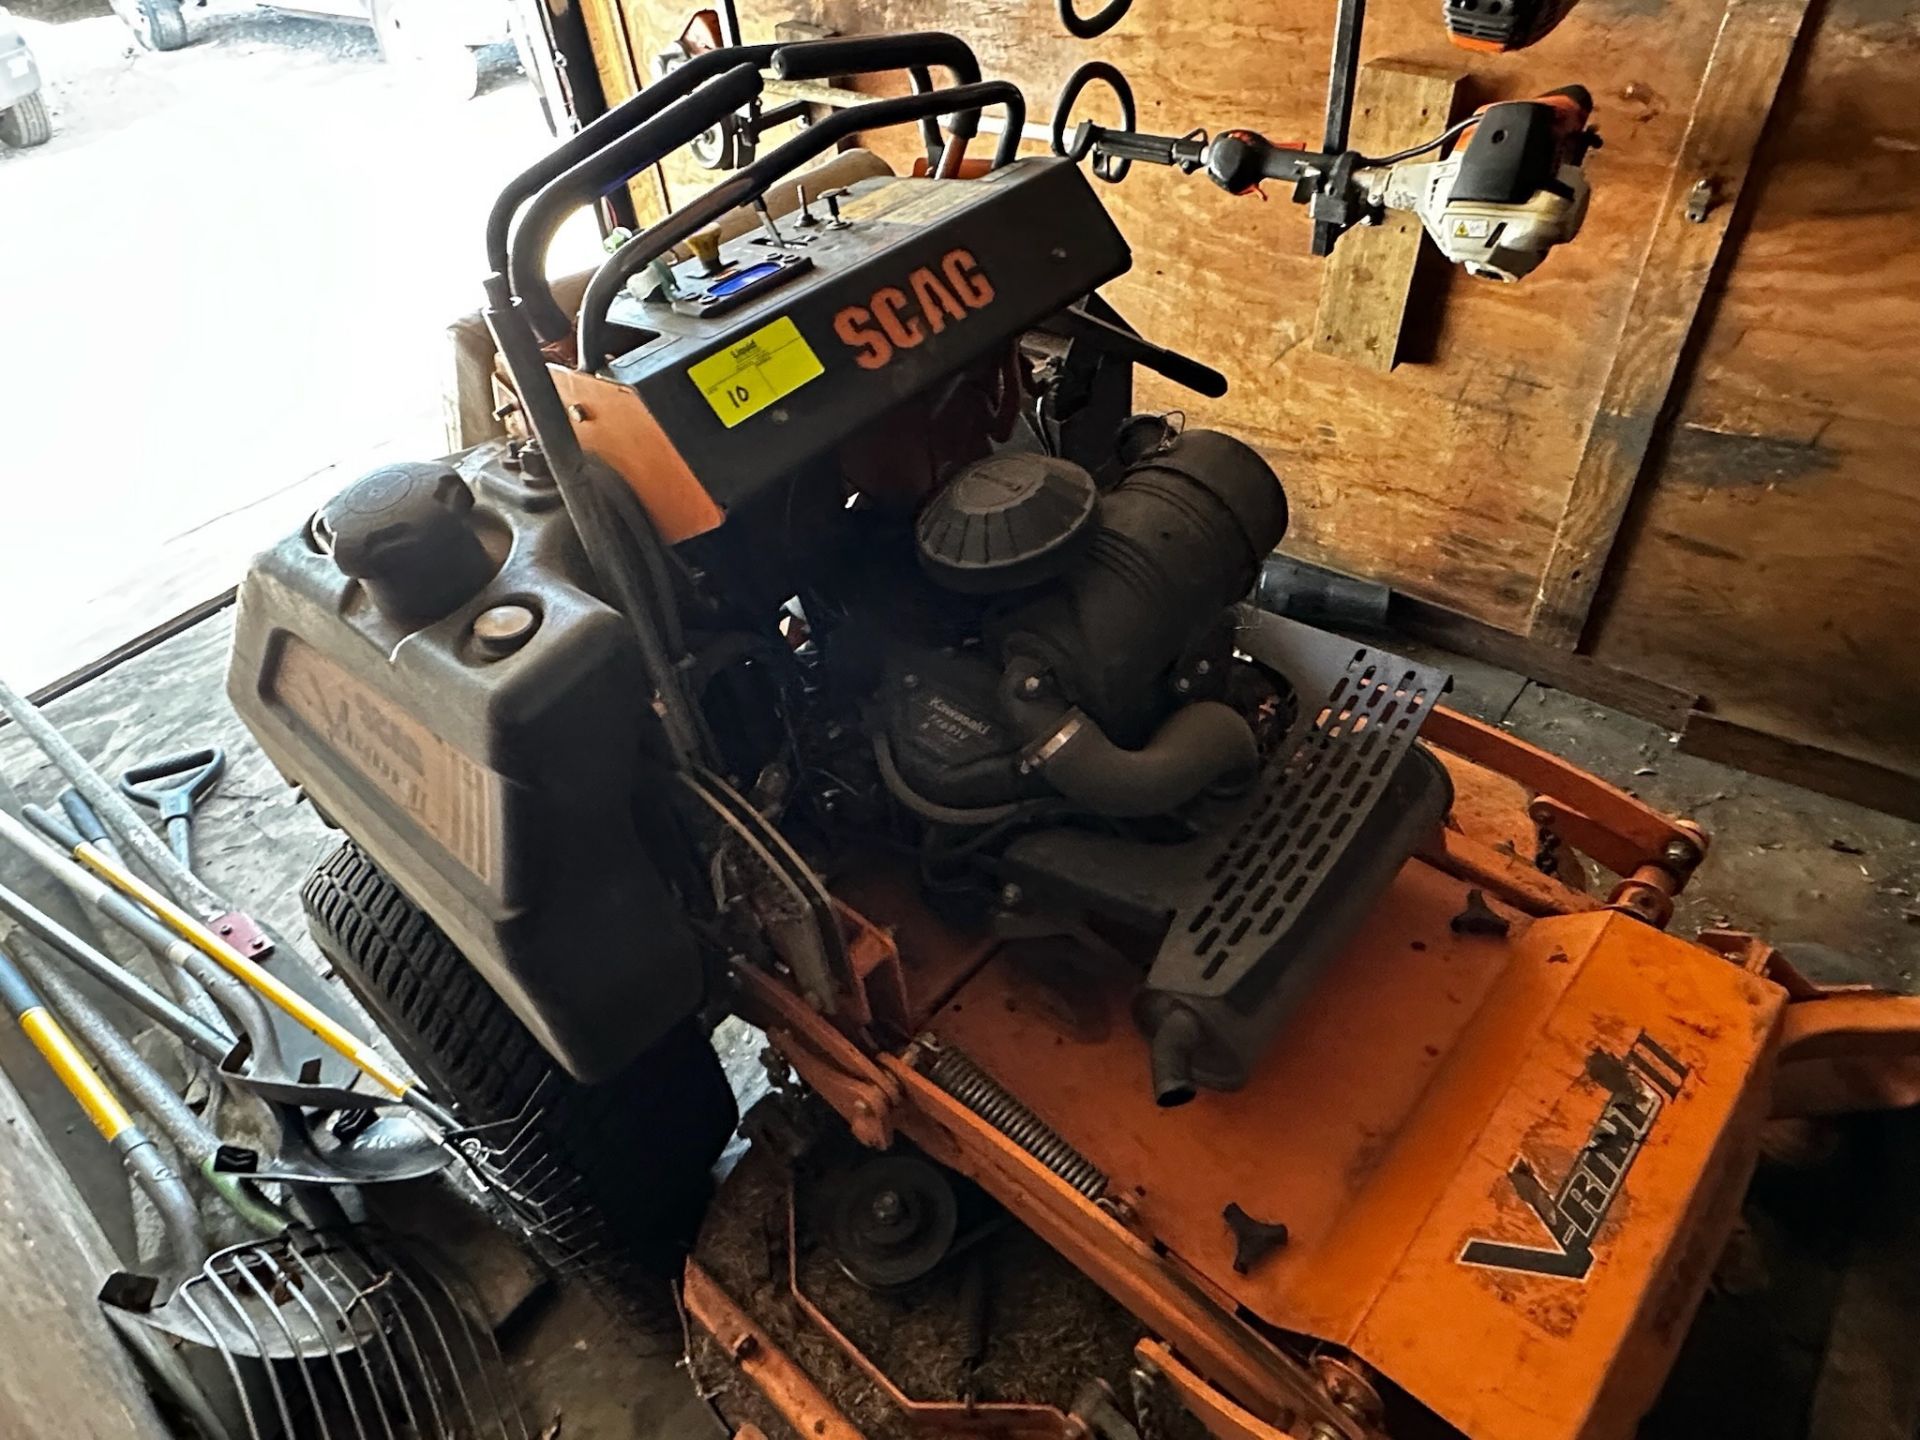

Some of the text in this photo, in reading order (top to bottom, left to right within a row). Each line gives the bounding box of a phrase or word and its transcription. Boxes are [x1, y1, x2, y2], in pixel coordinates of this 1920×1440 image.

[832, 247, 996, 370] SCAG
[726, 385, 750, 408] 10
[929, 696, 992, 735] Kawasaki
